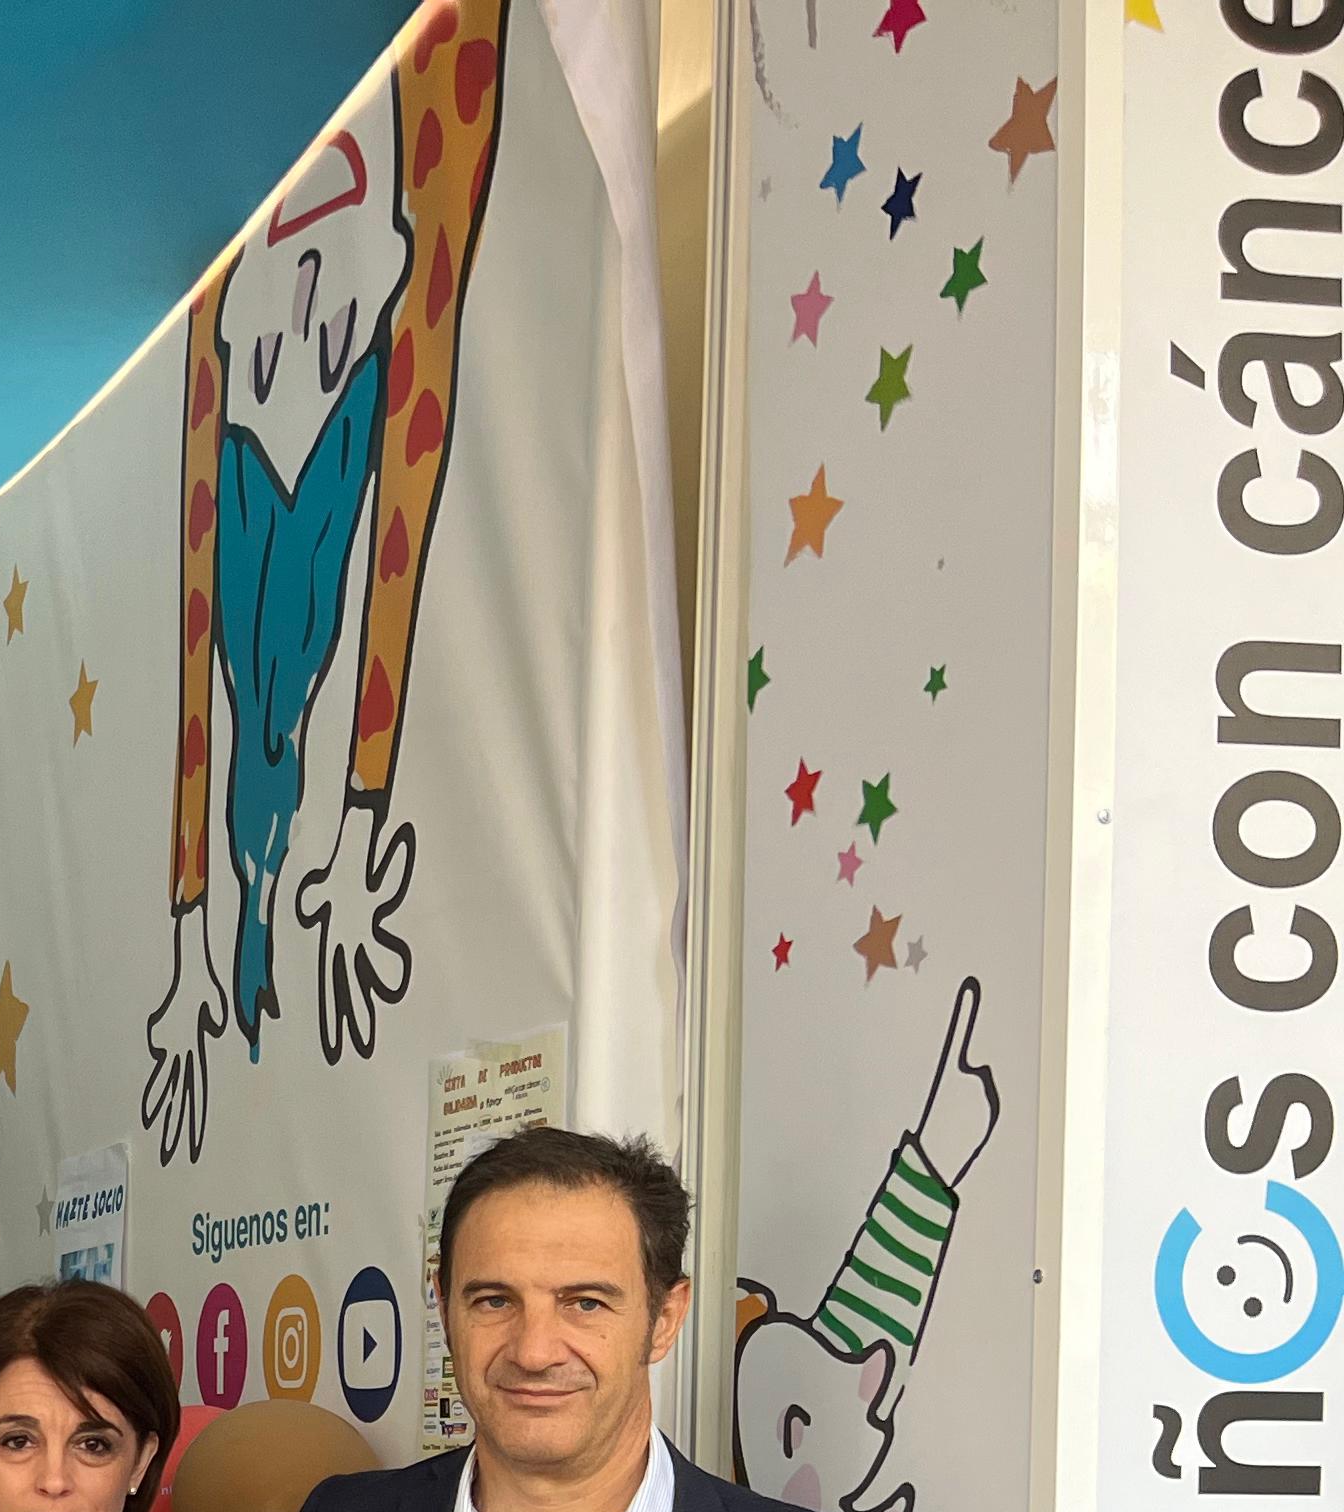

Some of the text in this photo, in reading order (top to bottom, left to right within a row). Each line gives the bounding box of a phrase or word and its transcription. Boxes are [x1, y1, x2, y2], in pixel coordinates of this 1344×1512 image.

[1206, 640, 1342, 1012] con
[55, 1184, 123, 1229] HAZTE SOCIO
[295, 1202, 330, 1240] en:
